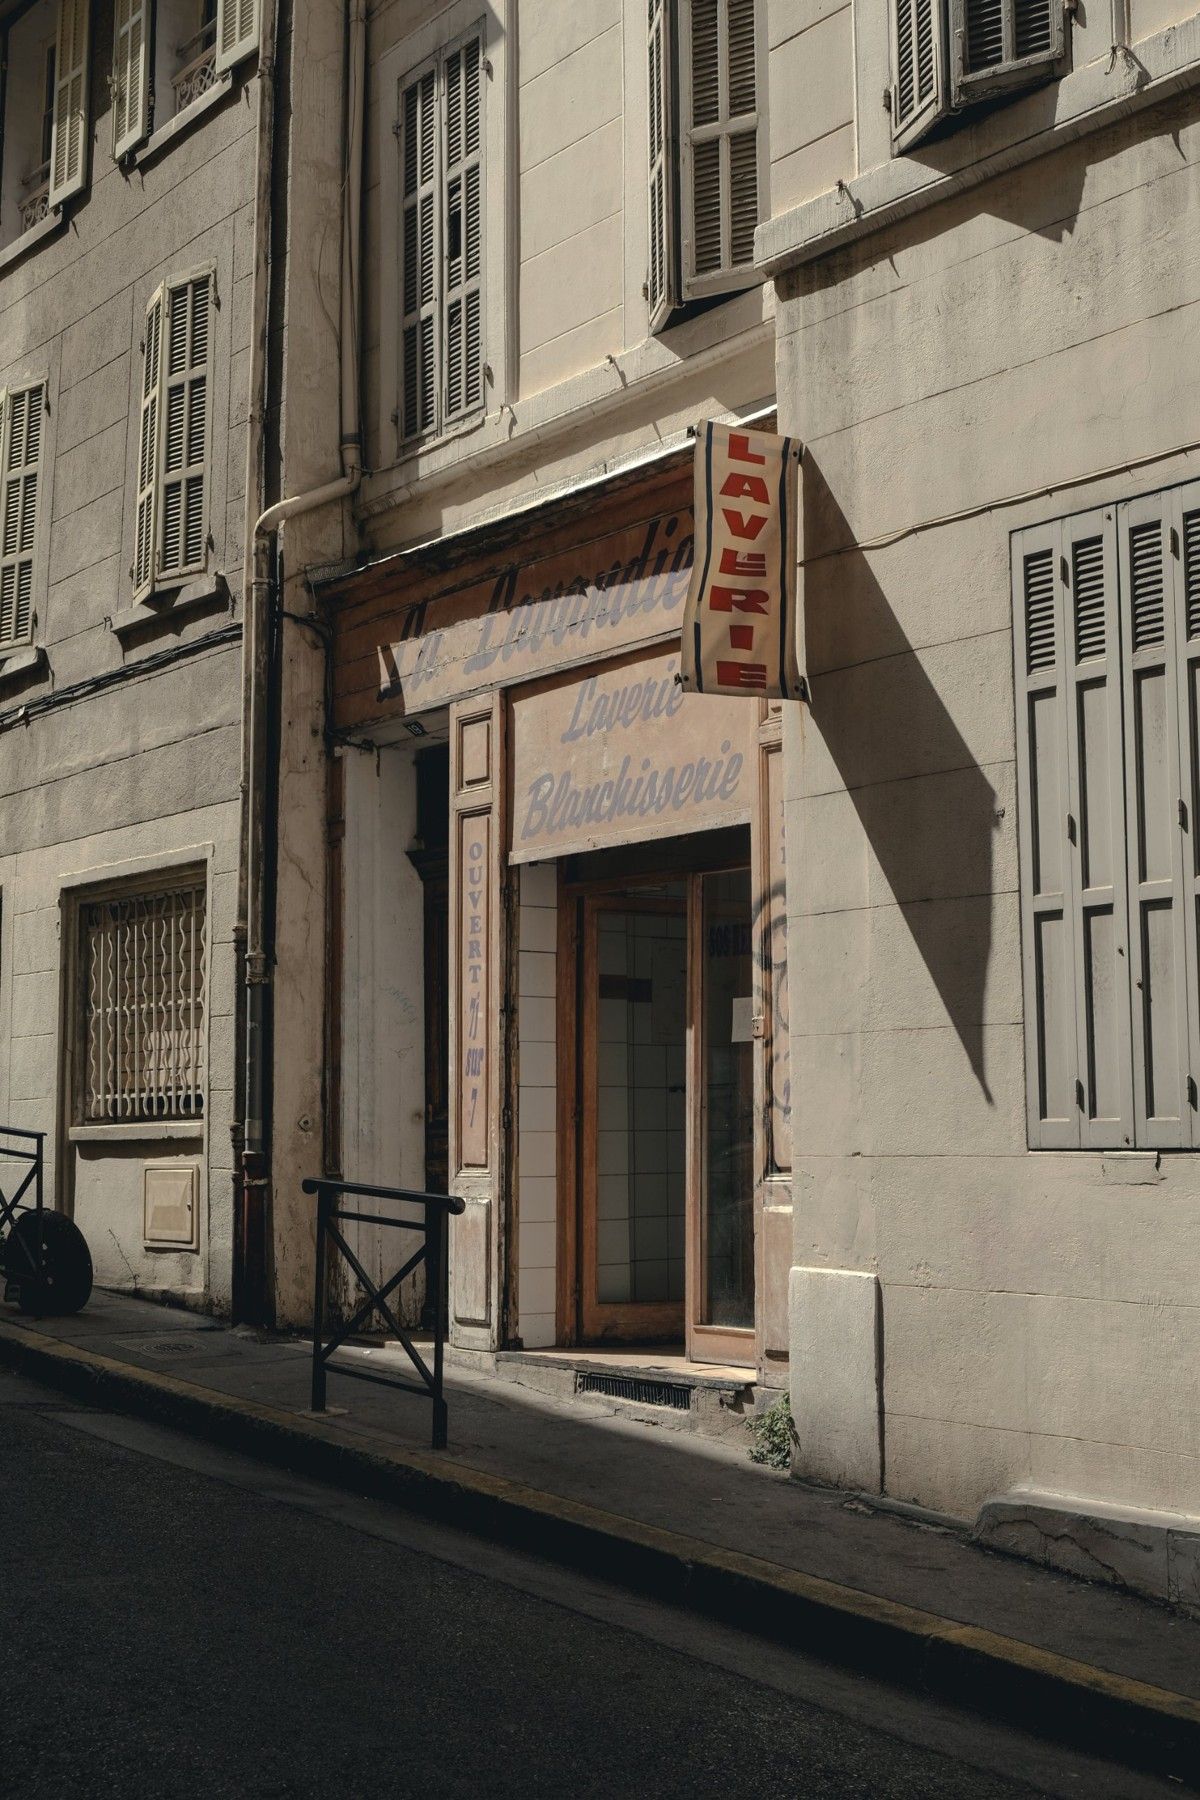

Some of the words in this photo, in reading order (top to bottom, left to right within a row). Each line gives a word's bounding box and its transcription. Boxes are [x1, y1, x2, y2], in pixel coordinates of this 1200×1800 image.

[709, 433, 771, 689] LAVERIE
[376, 599, 444, 704] La
[560, 658, 685, 744] Laverie
[520, 740, 744, 841] Blanchisserie
[467, 842, 483, 983] OUVERT
[465, 1048, 484, 1077] sur
[469, 1088, 478, 1128] 7
